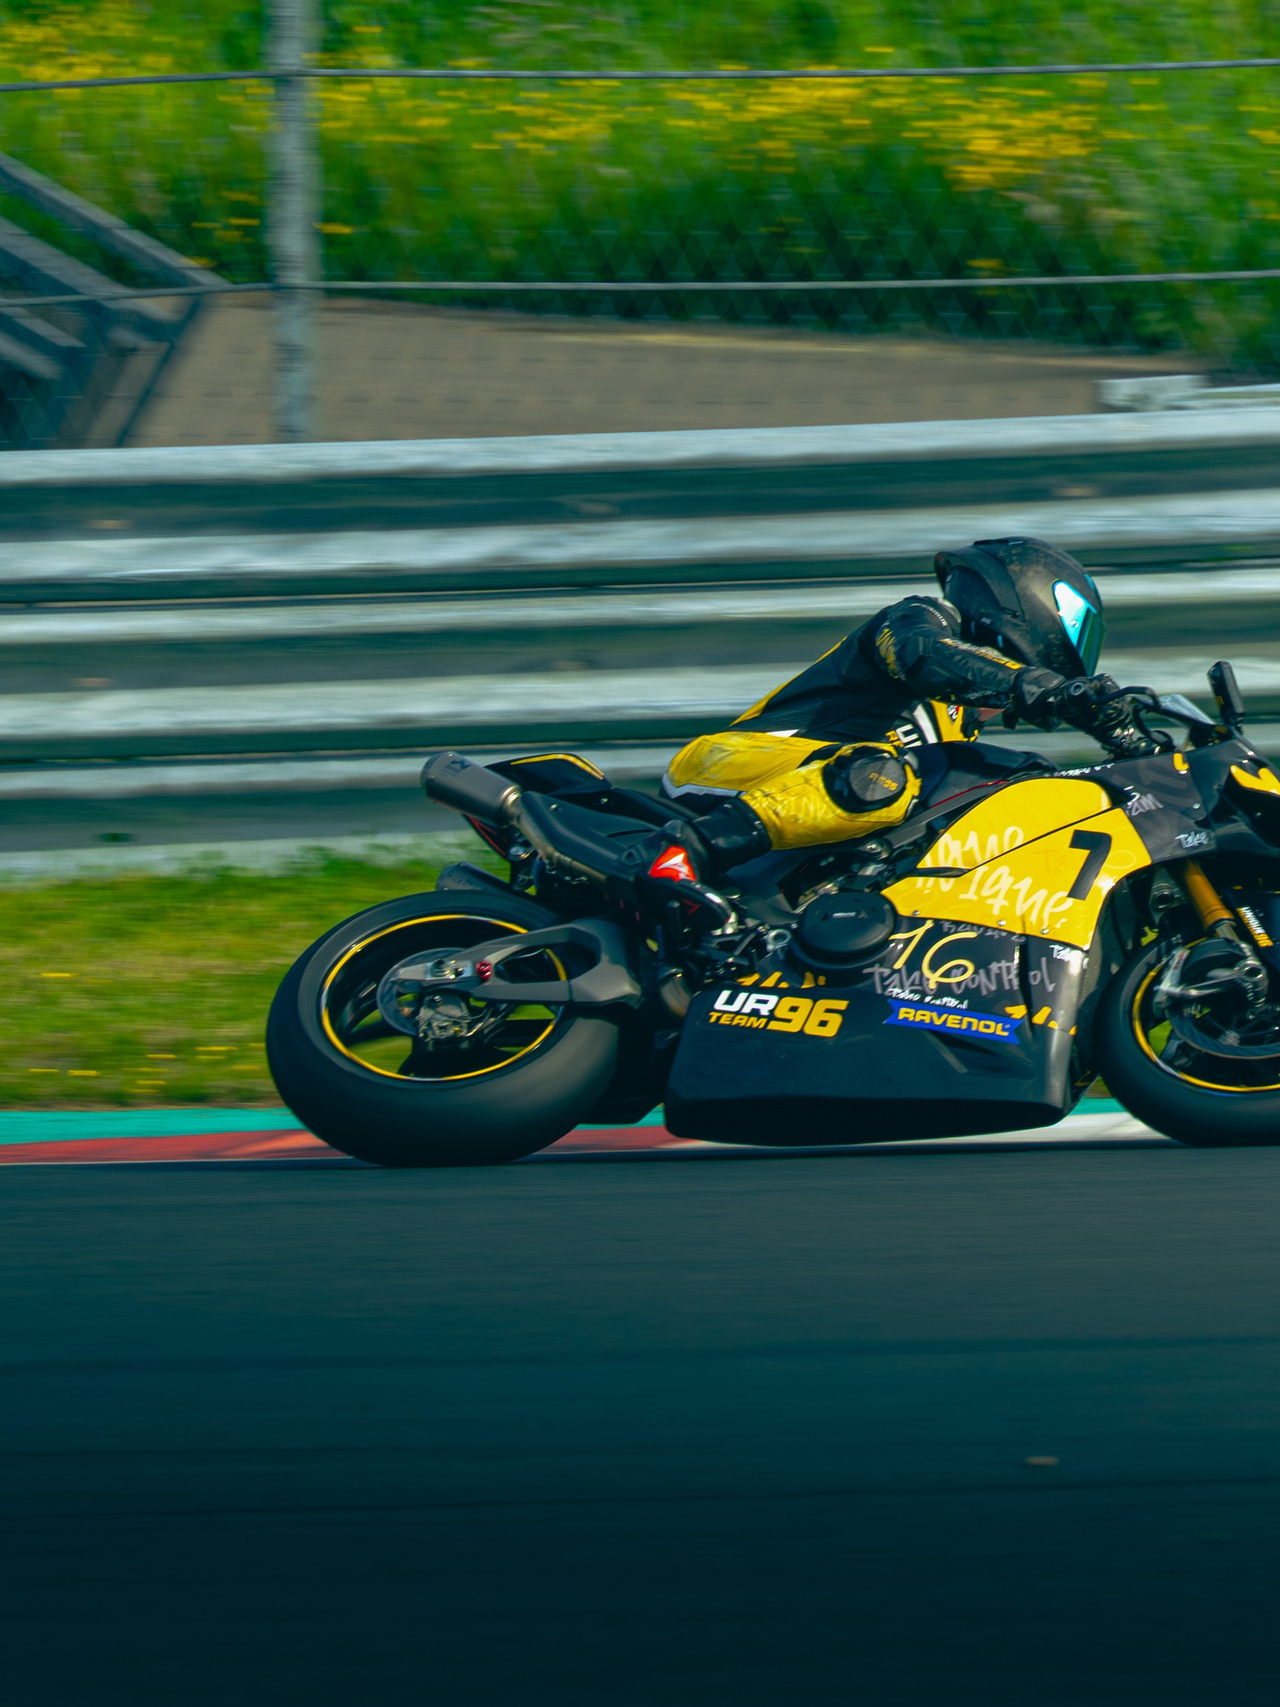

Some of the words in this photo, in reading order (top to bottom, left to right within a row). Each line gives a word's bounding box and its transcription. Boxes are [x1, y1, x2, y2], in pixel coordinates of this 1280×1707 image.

[1067, 829, 1112, 901] 7
[708, 1011, 768, 1029] TEAM
[897, 1007, 1010, 1037] RAVENOL
